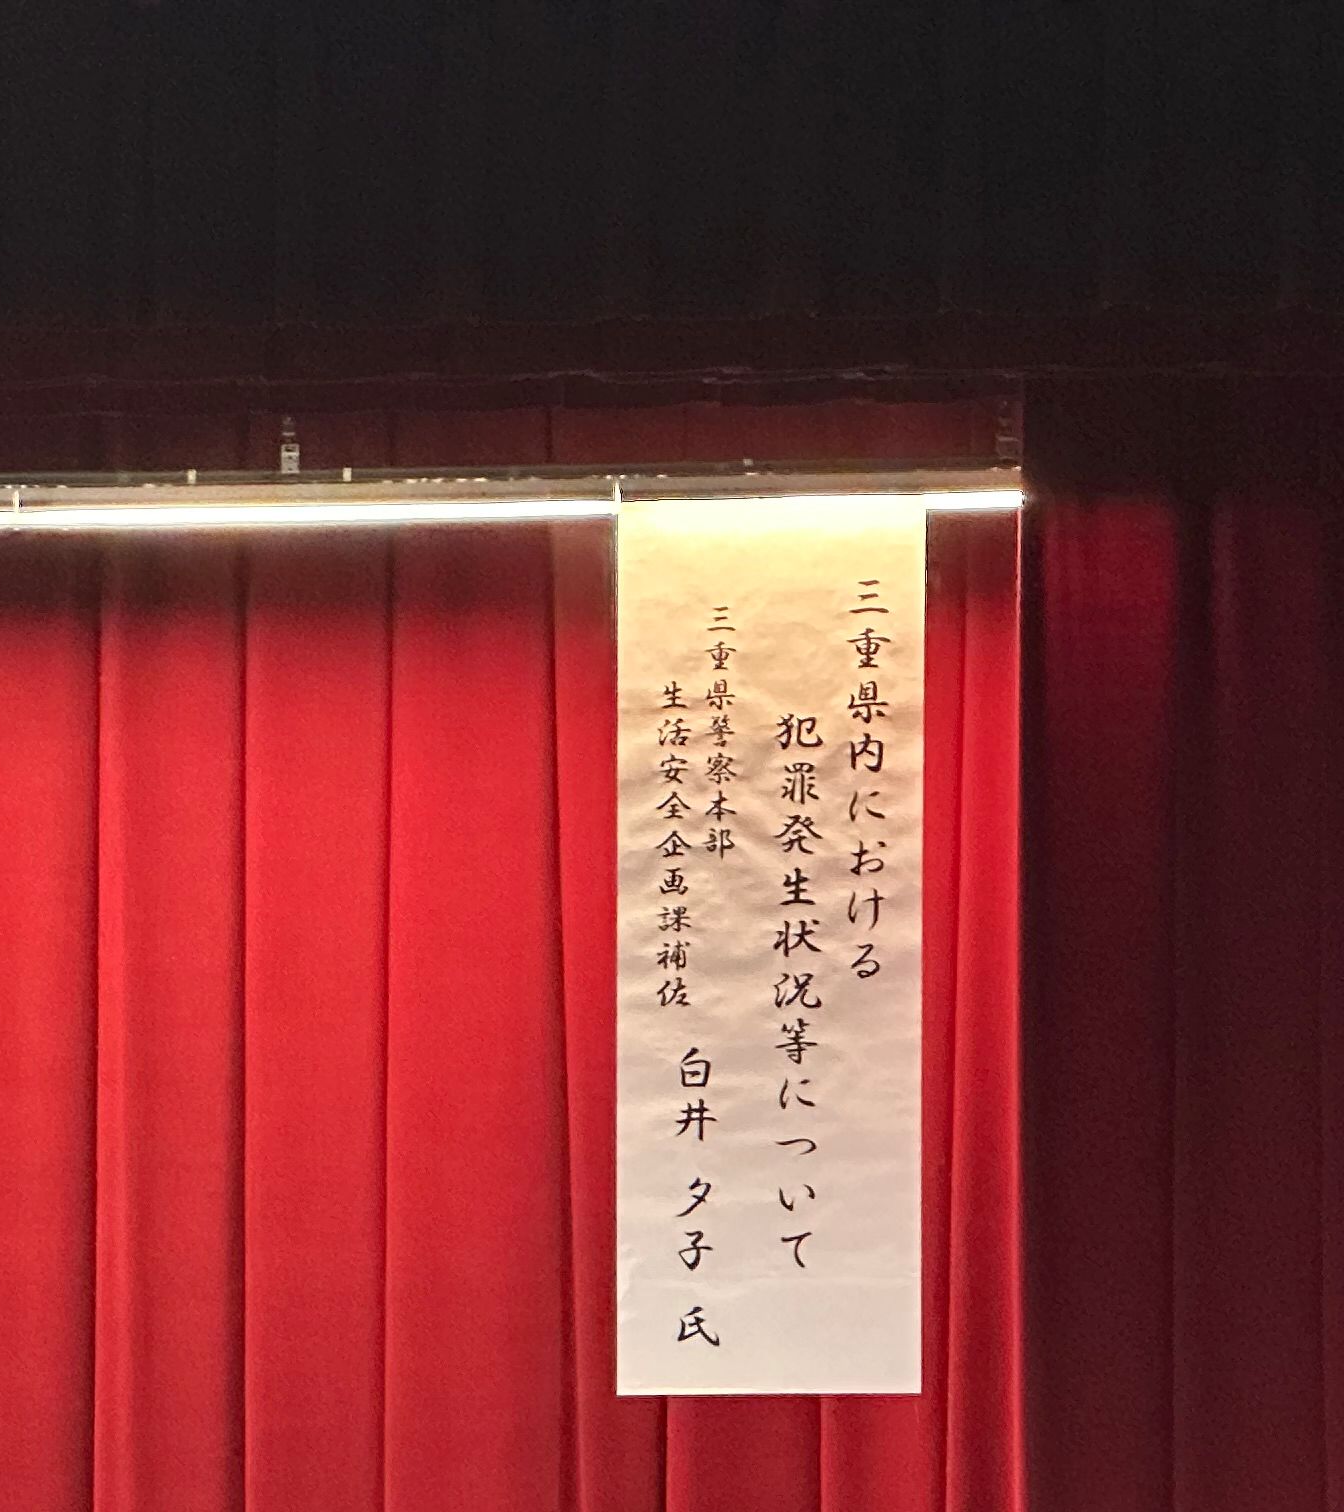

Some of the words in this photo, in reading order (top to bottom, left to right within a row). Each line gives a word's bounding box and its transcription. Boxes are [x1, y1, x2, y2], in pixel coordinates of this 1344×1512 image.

[655, 681, 691, 1007] 生活安全企画課補佐
[702, 606, 738, 861] 三重県警察本部
[848, 580, 891, 981] 三重県内における
[675, 1047, 717, 1141] 白井
[773, 713, 824, 1269] 犯罪発生状況等について
[675, 1176, 714, 1271] 夕子
[677, 1305, 720, 1348] 氏
